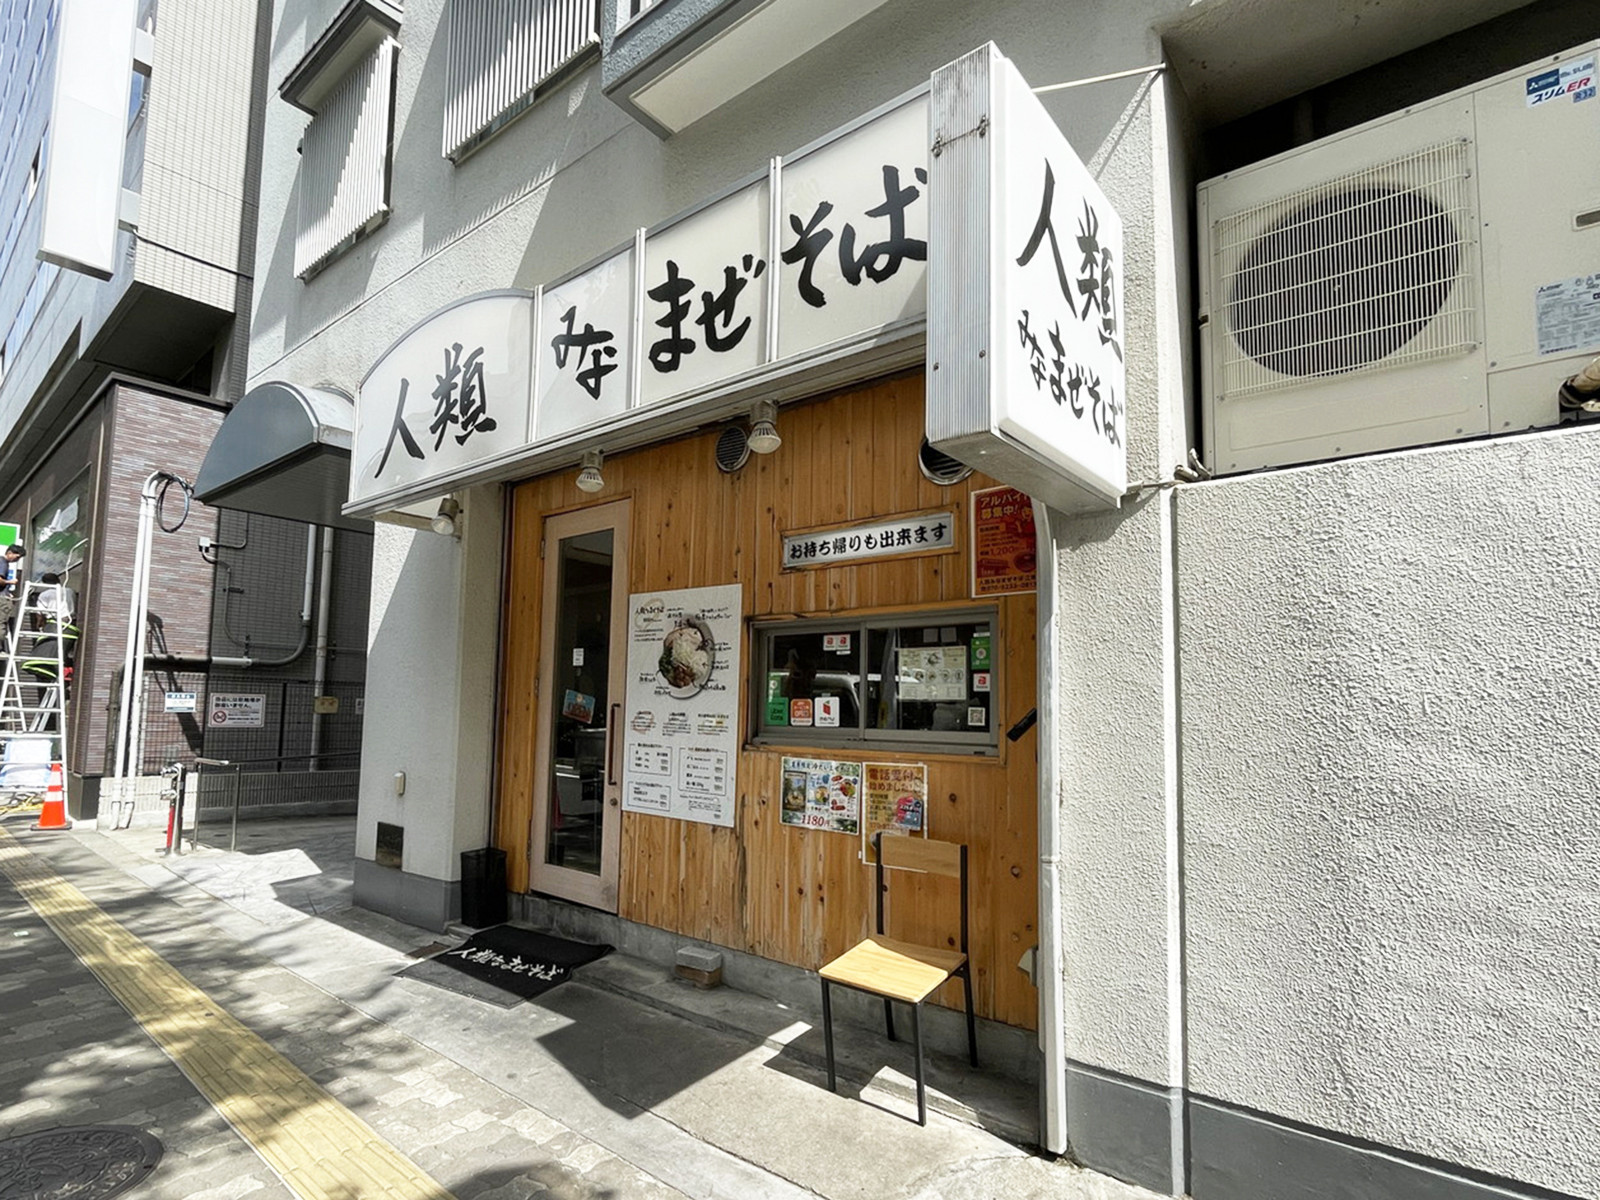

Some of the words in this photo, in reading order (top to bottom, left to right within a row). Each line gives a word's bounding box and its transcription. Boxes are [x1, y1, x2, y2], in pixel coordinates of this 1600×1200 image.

[1015, 157, 1123, 364] 人類
[1017, 309, 1124, 449] みなまぜそば
[789, 522, 948, 560] お持ち帰りも出来ます
